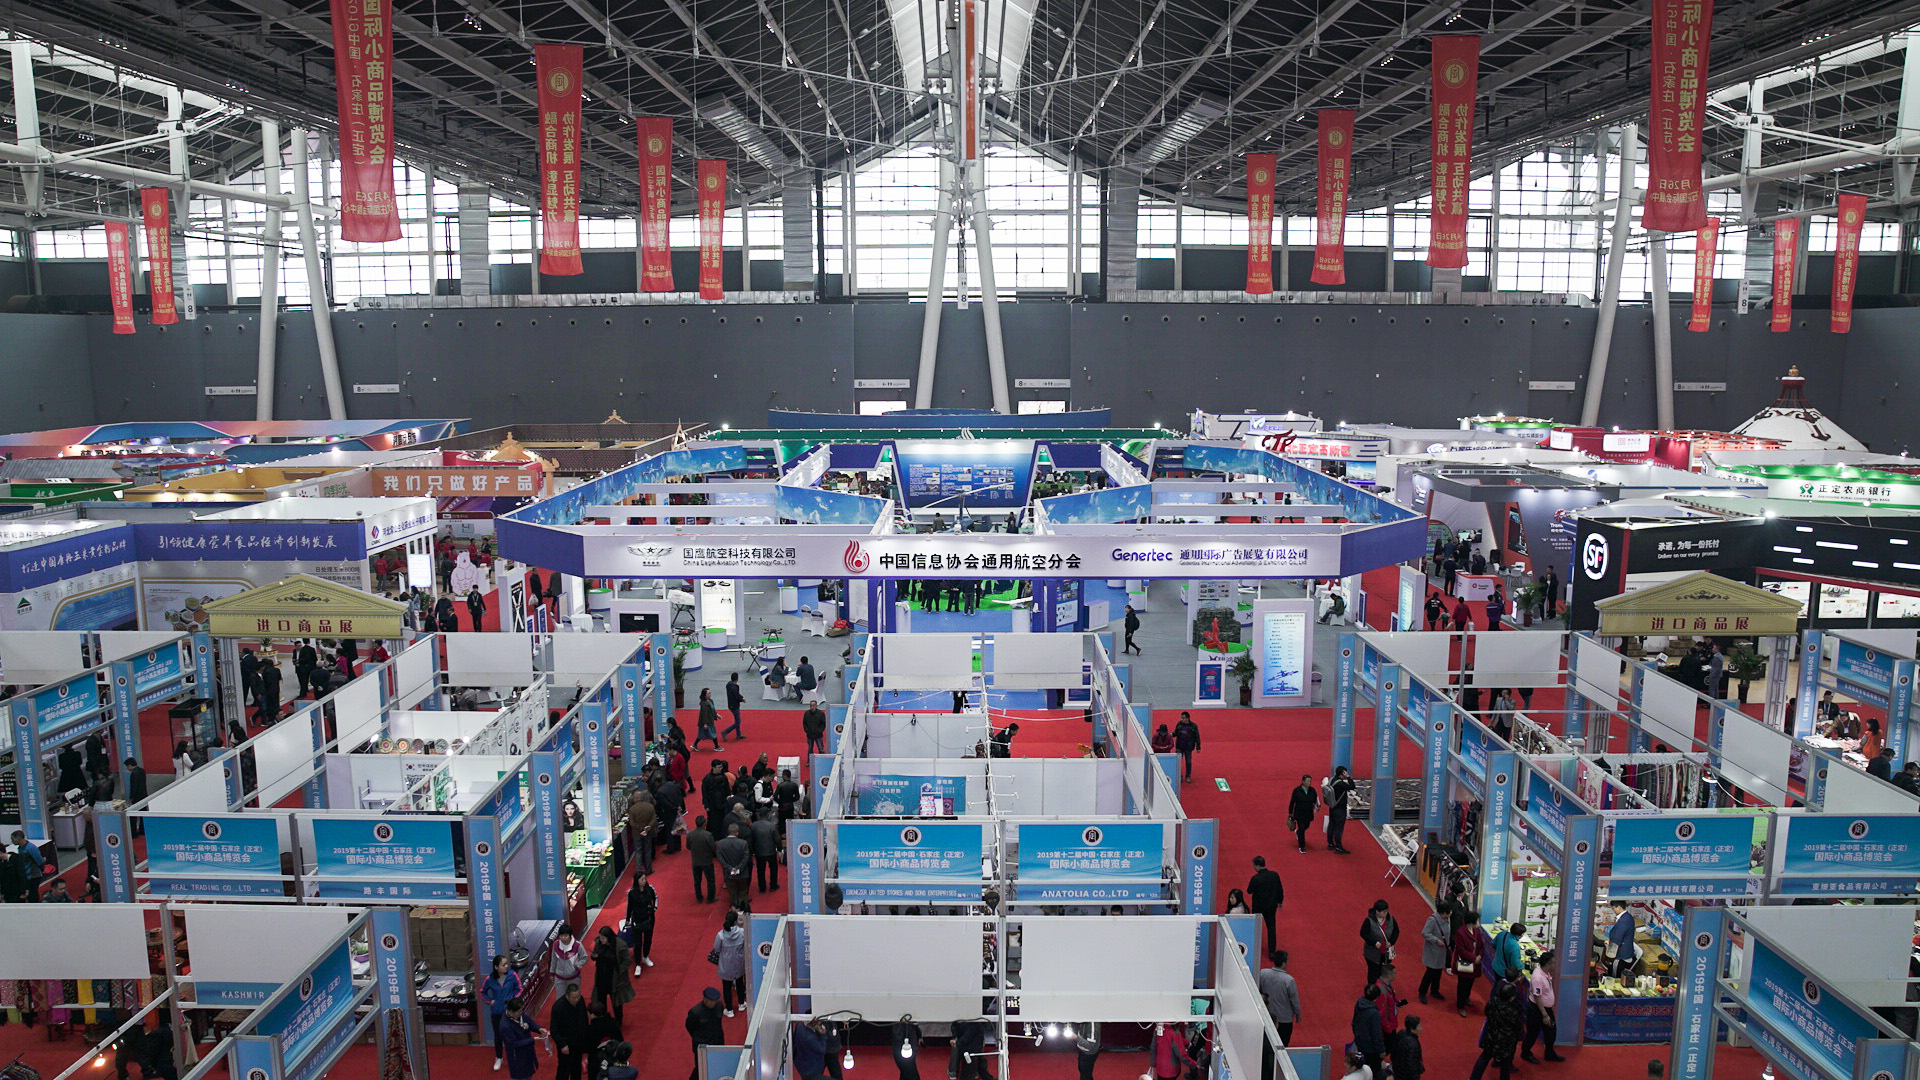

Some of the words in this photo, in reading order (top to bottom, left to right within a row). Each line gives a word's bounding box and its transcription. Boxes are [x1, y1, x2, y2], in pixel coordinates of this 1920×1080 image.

[961, 294, 967, 302] 8
[1742, 299, 1748, 307] 8
[188, 304, 194, 312] 8
[1276, 443, 1350, 456] 北正定高新区
[384, 475, 533, 492] 我们只做好产品
[1818, 484, 1892, 496] 正定农商银行
[159, 534, 338, 550] 引领健康营养食品经济创新发展
[683, 548, 796, 559] 国鹰航空科技有限公司
[1112, 548, 1174, 562] Genertec
[1179, 548, 1308, 560] 通用国际广告展览有限公司
[880, 553, 1082, 570] 中国信息协会通用航空分会
[257, 618, 354, 634] 进口商品展
[1651, 616, 1750, 631] 进口商品展
[1631, 846, 1734, 854] 2019第十二届中国·石家庄（正定）
[1803, 844, 1908, 852] 2019第十二届中国·石家庄（正定）
[175, 852, 251, 863] 国际小商品博览会
[346, 854, 424, 865] 国际小商品博览会
[1642, 854, 1720, 864] 国际小商品博览会
[1814, 852, 1893, 862] 国际小商品博览会
[869, 858, 950, 869] 国际小商品博览会
[1049, 859, 1130, 869] 国际小商品博览会
[1630, 884, 1714, 894] 金雄电器科技有限公司
[1812, 882, 1887, 891] 亚细亚食品有限公司
[1092, 890, 1129, 898] CO.,LTD
[1568, 860, 1585, 963] 2019中国·石家庄（正定）
[221, 990, 265, 1000] KASHMIR
[1686, 957, 1707, 1079] 2019中国·石家庄（正定）
[1764, 977, 1856, 1054] 2019第十二届中国·石家庄（正定
[1773, 995, 1843, 1059] 国际小商品博览会
